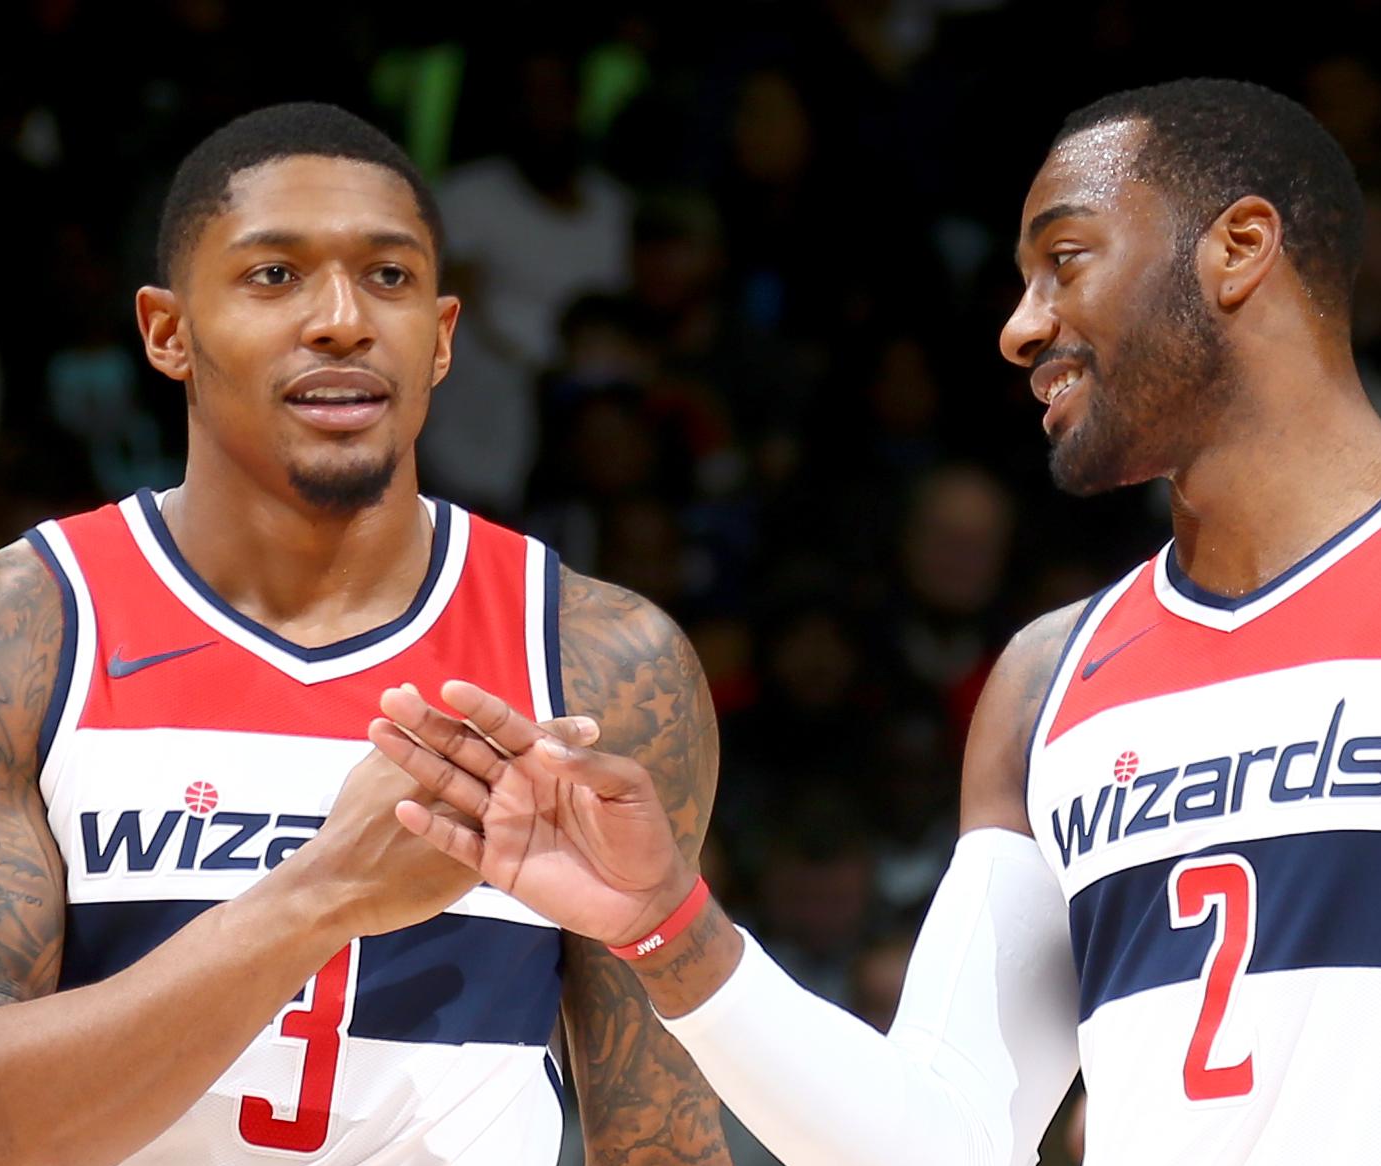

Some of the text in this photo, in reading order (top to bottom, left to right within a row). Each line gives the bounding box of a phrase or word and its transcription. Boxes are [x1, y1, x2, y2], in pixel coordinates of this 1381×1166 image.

[80, 781, 327, 874] wiza
[636, 934, 665, 956] JW2
[1175, 862, 1255, 1102] 2
[238, 941, 352, 1155] 3
